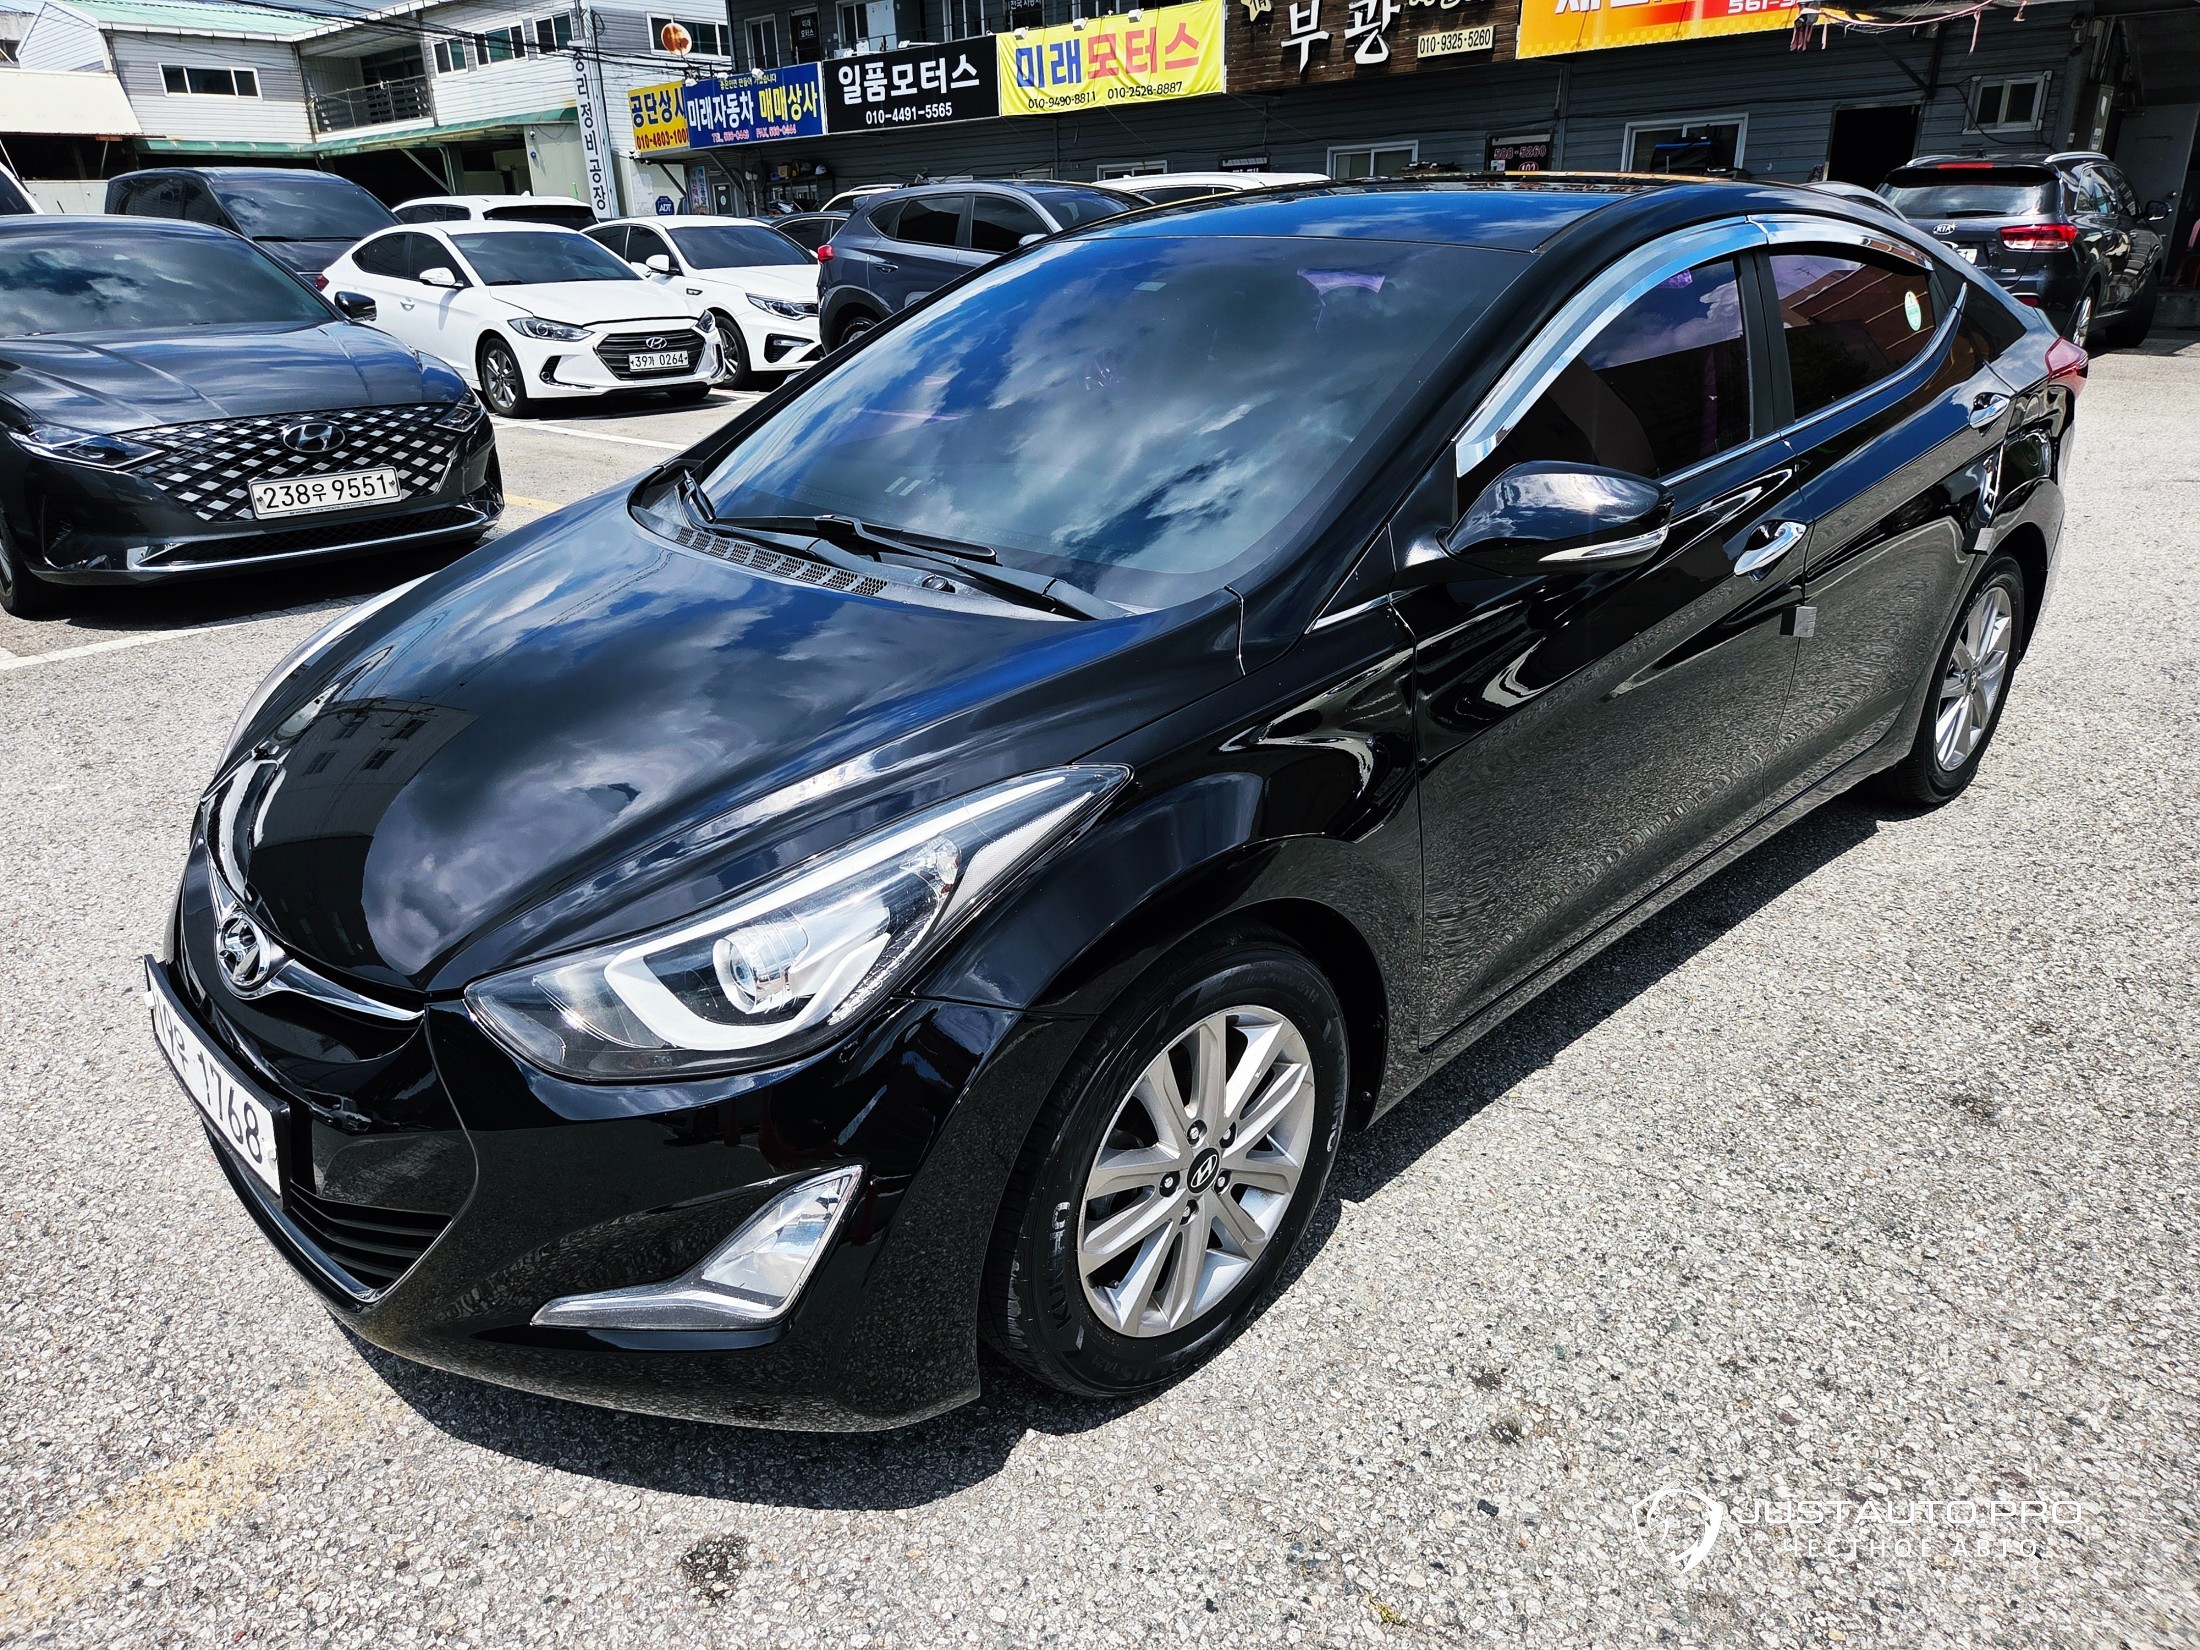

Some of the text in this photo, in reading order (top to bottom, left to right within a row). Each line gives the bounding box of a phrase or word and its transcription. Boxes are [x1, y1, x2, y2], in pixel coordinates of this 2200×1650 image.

[800, 29, 814, 38] 모터스
[1016, 22, 1200, 88] 미래모터스
[838, 53, 980, 105] 일품모터스
[1107, 81, 1183, 100] 010-2528-8887
[687, 81, 818, 131] 미래자동차 매매상사
[1028, 91, 1096, 109] 010-9490-8811
[865, 102, 953, 125] 010-4491-5565
[659, 203, 672, 212] ADT
[659, 352, 684, 366] 0264
[263, 483, 327, 509] 238우
[331, 473, 388, 501] 9551
[197, 1050, 263, 1165] 1768
